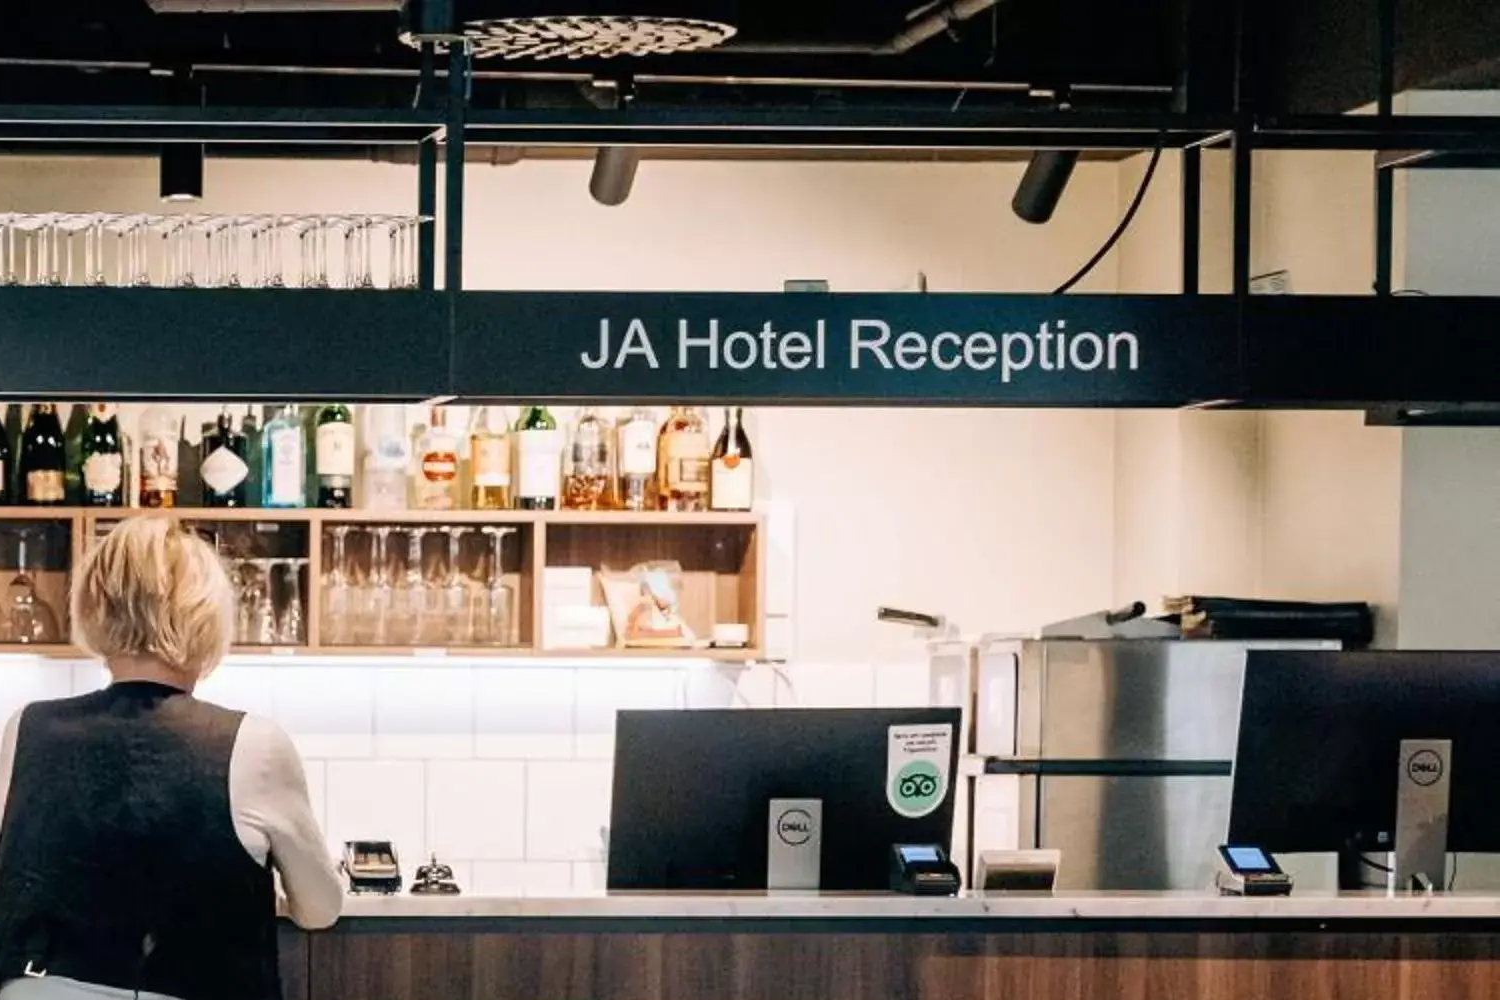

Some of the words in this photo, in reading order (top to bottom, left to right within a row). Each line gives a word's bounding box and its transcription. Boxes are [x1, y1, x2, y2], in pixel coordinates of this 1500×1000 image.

[580, 317, 660, 370] JA
[677, 318, 826, 371] Hotel
[849, 319, 1139, 383] Reception
